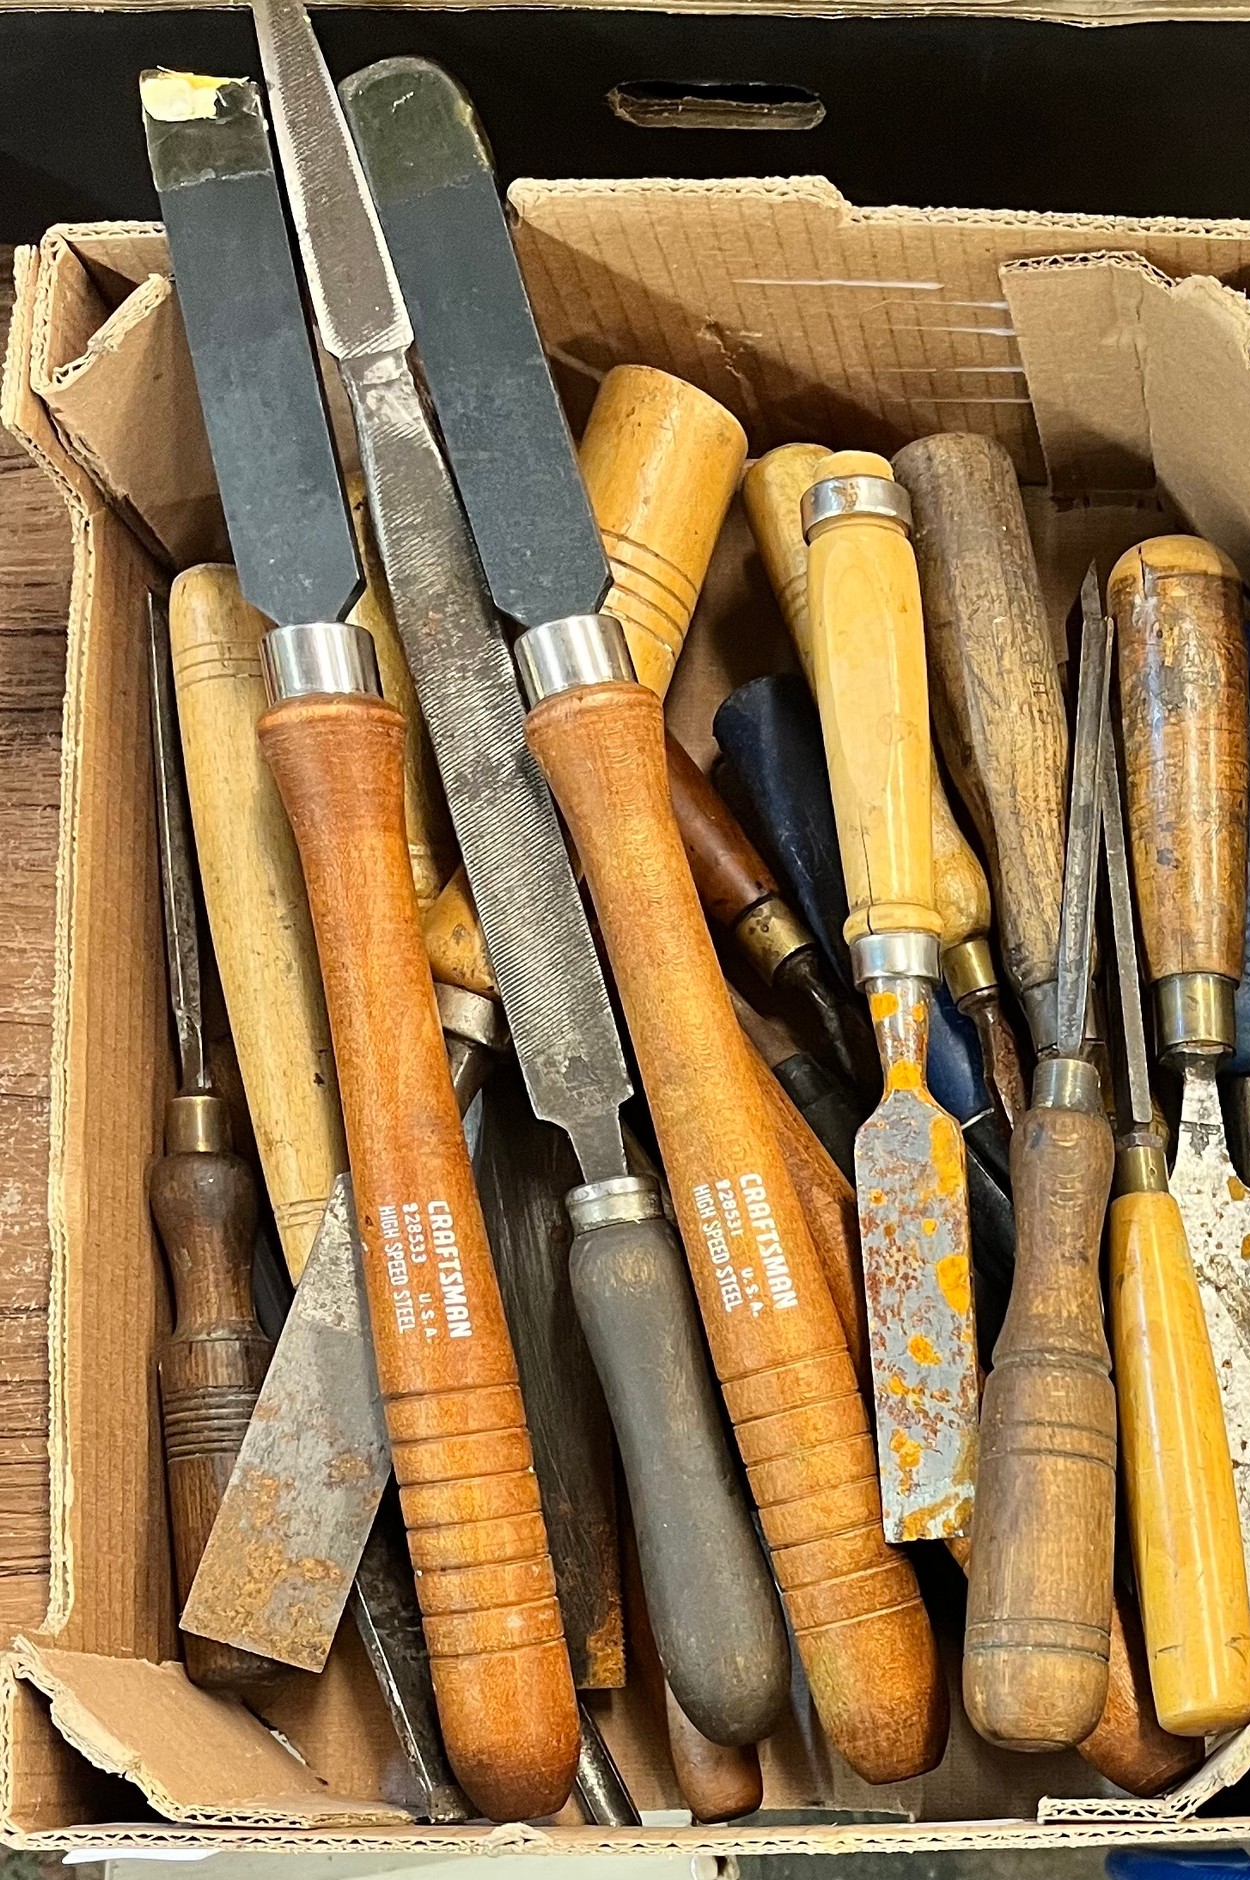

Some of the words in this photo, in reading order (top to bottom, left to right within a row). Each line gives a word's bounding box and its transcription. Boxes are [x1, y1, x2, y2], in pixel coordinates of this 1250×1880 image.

[378, 1205, 400, 1240] HIGH
[693, 1184, 716, 1219] HIGH
[402, 1202, 427, 1264] 928533
[701, 1219, 731, 1265] SPEED
[739, 1173, 798, 1310] CRAFTSMAN
[384, 1242, 409, 1287] SPEED
[428, 1201, 473, 1338] CRAFTSMAN
[392, 1290, 415, 1334] STEEL
[715, 1266, 744, 1313] STEEL
[740, 1266, 763, 1318] U.S.A.
